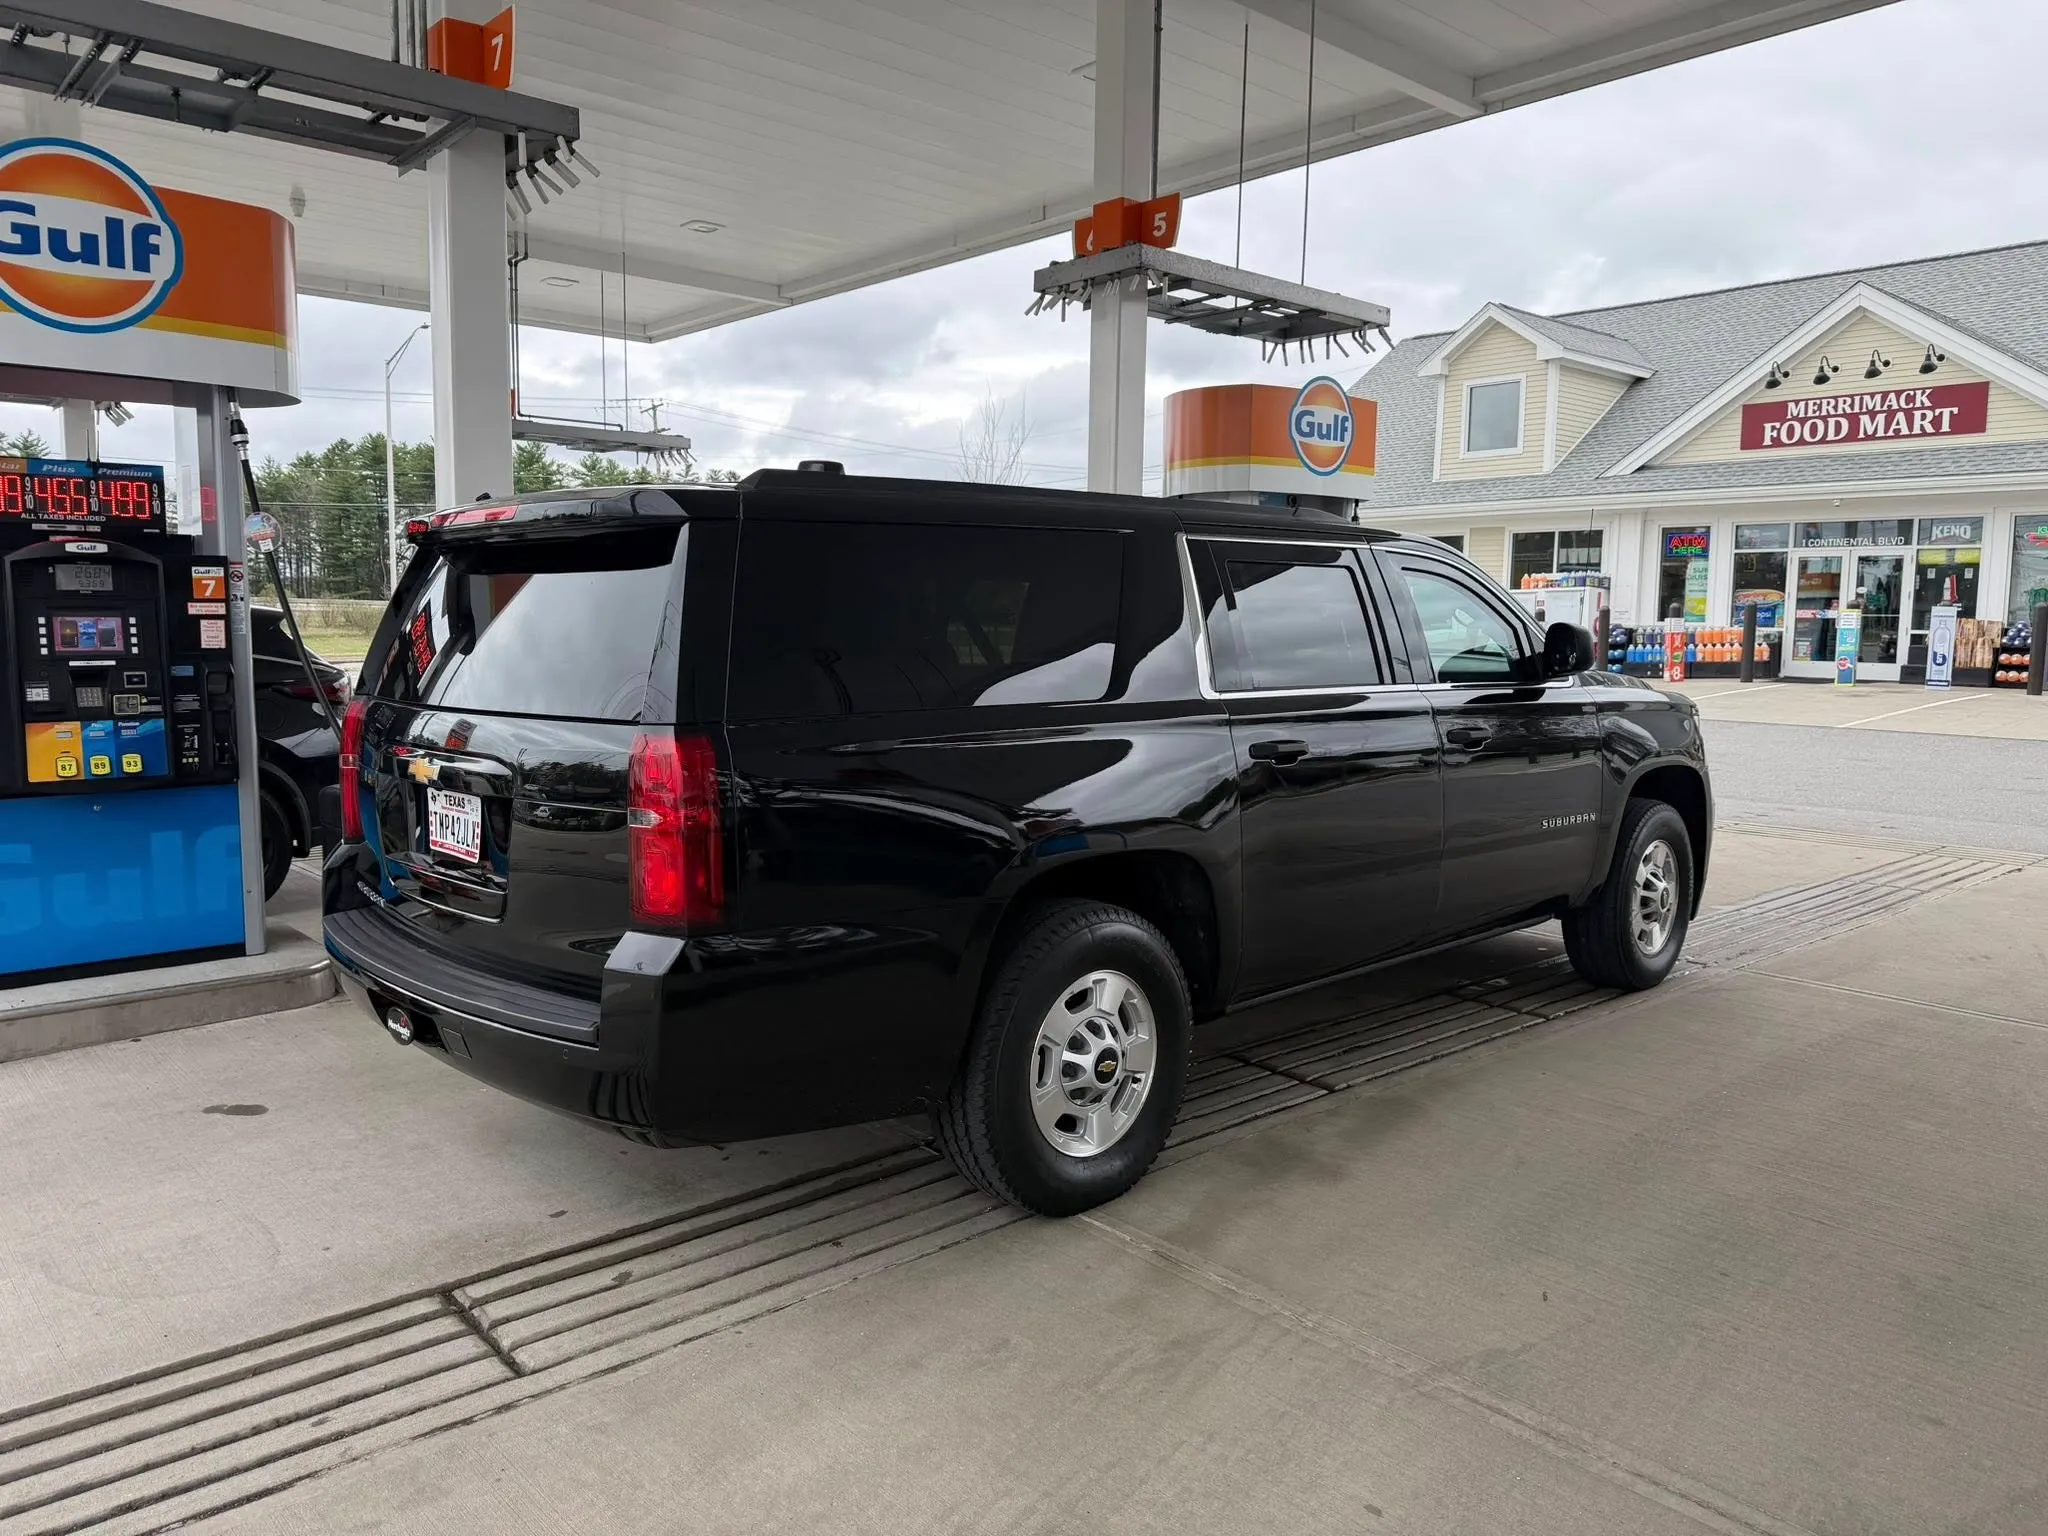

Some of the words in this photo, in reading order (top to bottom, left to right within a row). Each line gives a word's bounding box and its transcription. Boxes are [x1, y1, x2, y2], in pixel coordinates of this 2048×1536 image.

[491, 32, 504, 72] 7
[1152, 211, 1167, 237] 5
[0, 199, 162, 274] Gulf
[1786, 388, 1933, 419] MERRIMACK
[1295, 409, 1350, 443] Gulf
[1762, 416, 1849, 446] FOOD
[1857, 407, 1959, 439] MART
[42, 464, 75, 474] Plus
[98, 467, 153, 478] Premium
[21, 512, 36, 520] ALL
[38, 513, 64, 521] TAXES
[66, 514, 106, 522] INCLUDED
[1931, 524, 1972, 541] KENO
[76, 543, 97, 551] Gulf
[1670, 534, 1707, 548] ATM
[1808, 537, 1875, 547] CONTINENTAL
[1878, 536, 1905, 546] BLVD
[201, 579, 216, 597] 7
[60, 763, 73, 772] 87
[93, 761, 106, 770] 89
[126, 759, 138, 768] 93
[444, 794, 466, 809] TEXAS
[1542, 812, 1596, 829] SUBURBAN
